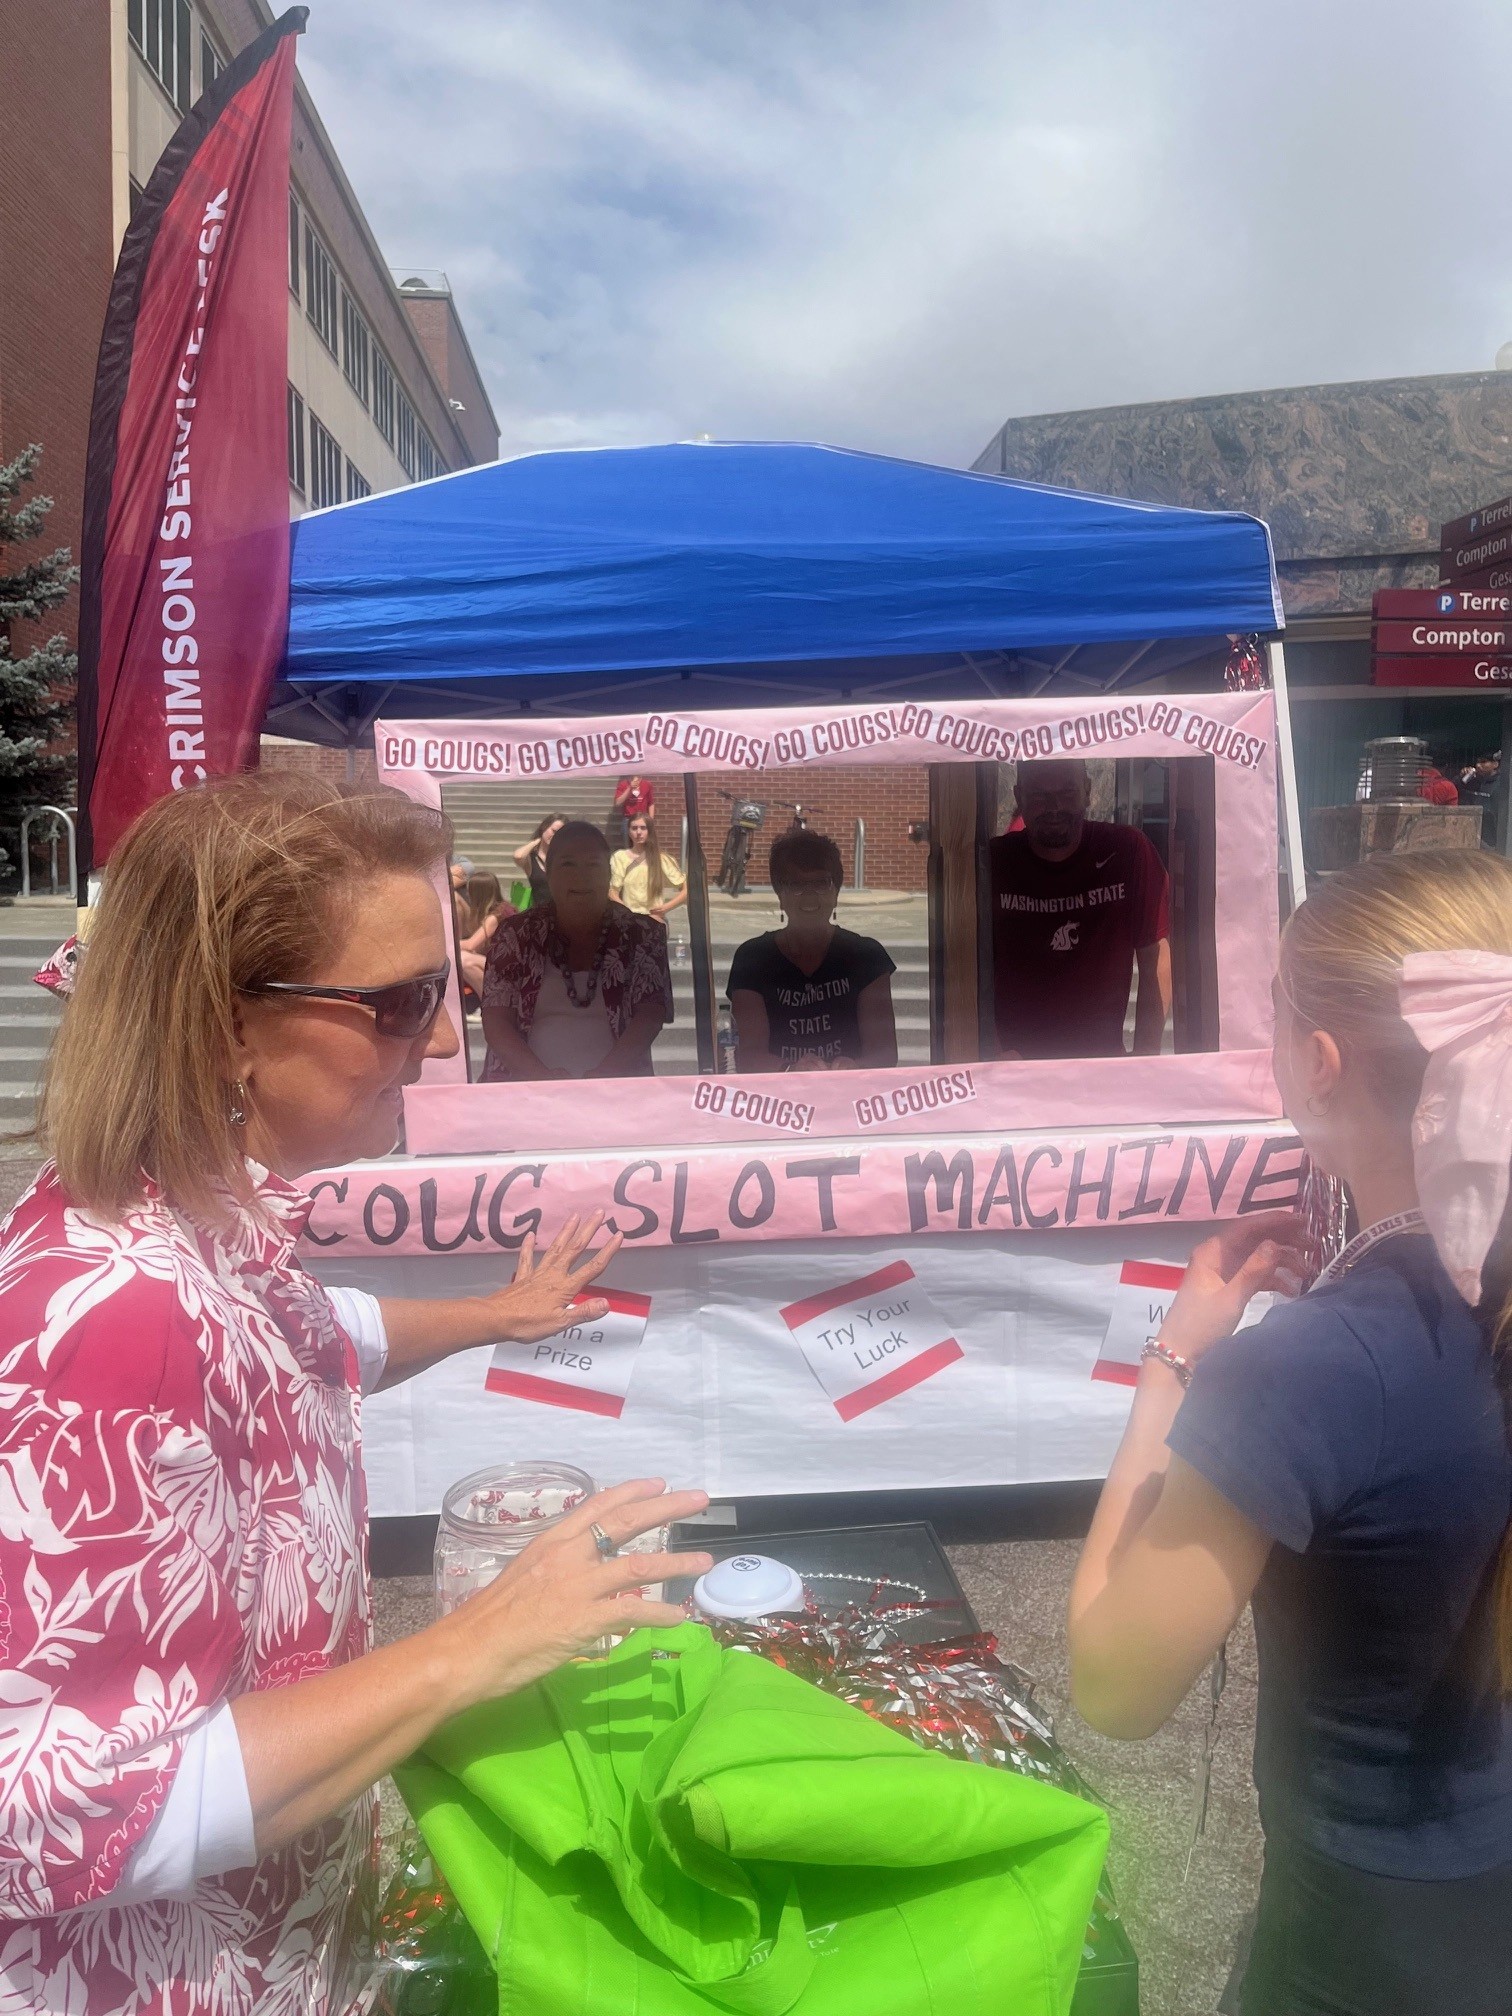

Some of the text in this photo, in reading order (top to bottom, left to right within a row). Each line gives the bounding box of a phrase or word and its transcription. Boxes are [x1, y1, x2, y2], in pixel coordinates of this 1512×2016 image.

[1456, 537, 1507, 567] Compton
[1412, 626, 1505, 650] Compton
[160, 556, 207, 792] CRIMSON
[385, 737, 511, 773] GO COUGS!
[518, 729, 643, 774] GO COUGS!
[646, 715, 771, 770] GO COUGS!
[774, 709, 899, 760] GO COUGS!
[899, 704, 1020, 764] GO COUGS!
[1021, 704, 1146, 759] GO COUGS!
[1147, 701, 1266, 769] GO COUGS!
[1000, 882, 1126, 913] WASHINGTON STATE
[789, 1014, 832, 1036] STATE
[694, 1081, 816, 1132] GO COUGS!
[855, 1069, 976, 1126] GO COUGS!
[303, 1133, 1305, 1252] COUG SLOT MACHINE
[554, 1327, 604, 1343] in a
[817, 1298, 911, 1351] Try Your
[853, 1330, 909, 1370] Luck
[534, 1345, 592, 1371] Prize
